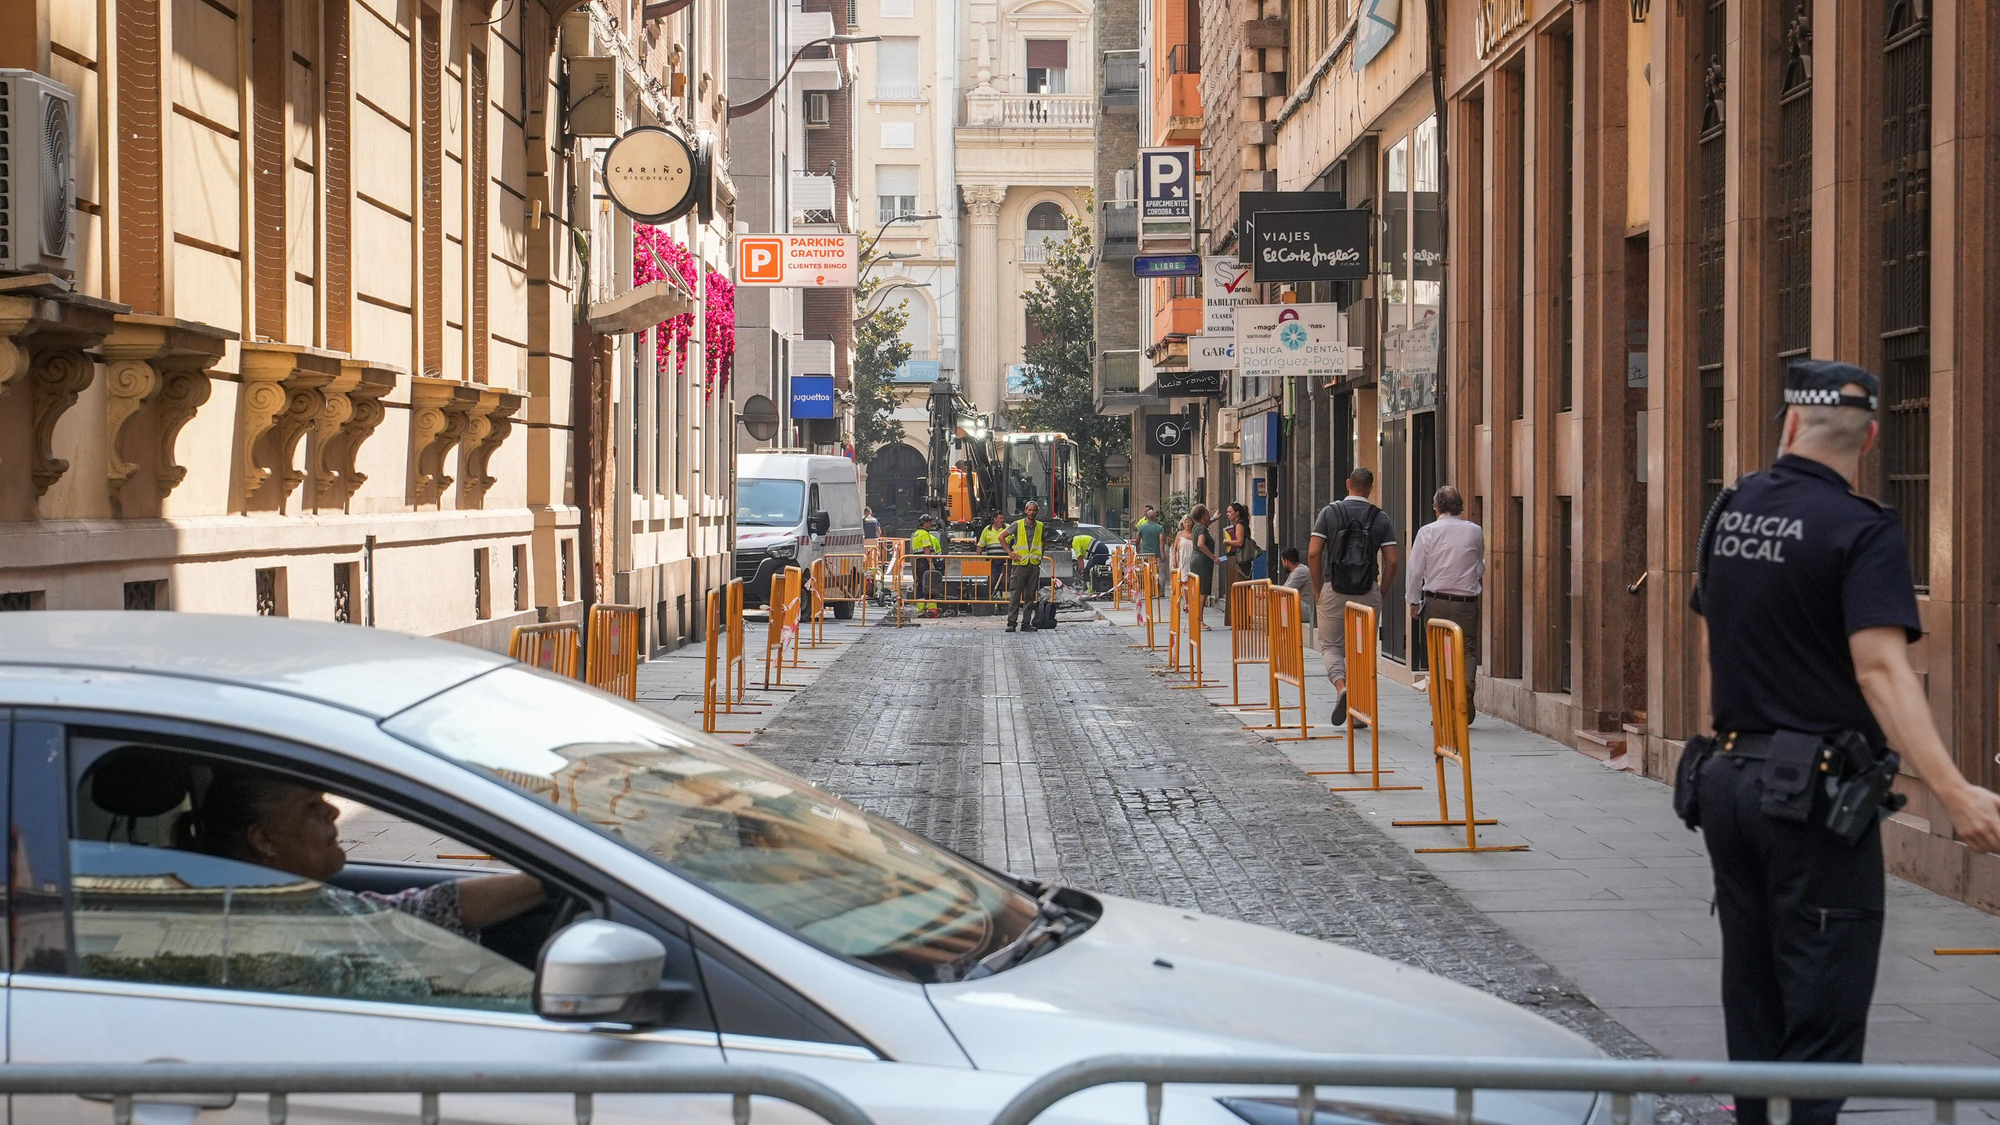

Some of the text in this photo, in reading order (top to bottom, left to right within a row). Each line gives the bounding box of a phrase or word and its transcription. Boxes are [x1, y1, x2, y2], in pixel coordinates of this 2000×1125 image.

[615, 165, 683, 174] CARIÑO
[1151, 155, 1182, 197] P
[790, 238, 845, 247] PARKING
[1263, 231, 1311, 243] VIAJES
[790, 249, 845, 258] GRATUITO
[1278, 247, 1311, 262] Corte
[1312, 243, 1360, 267] Inglés
[751, 248, 772, 273] P
[1154, 262, 1180, 270] LIBRE
[1243, 345, 1344, 354] CLÍNICA DENTAL
[1243, 355, 1344, 368] Rodríguez-Poyo
[793, 393, 830, 402] juguettos
[1715, 511, 1804, 540] POLICIA
[1713, 534, 1785, 563] LOCAL
